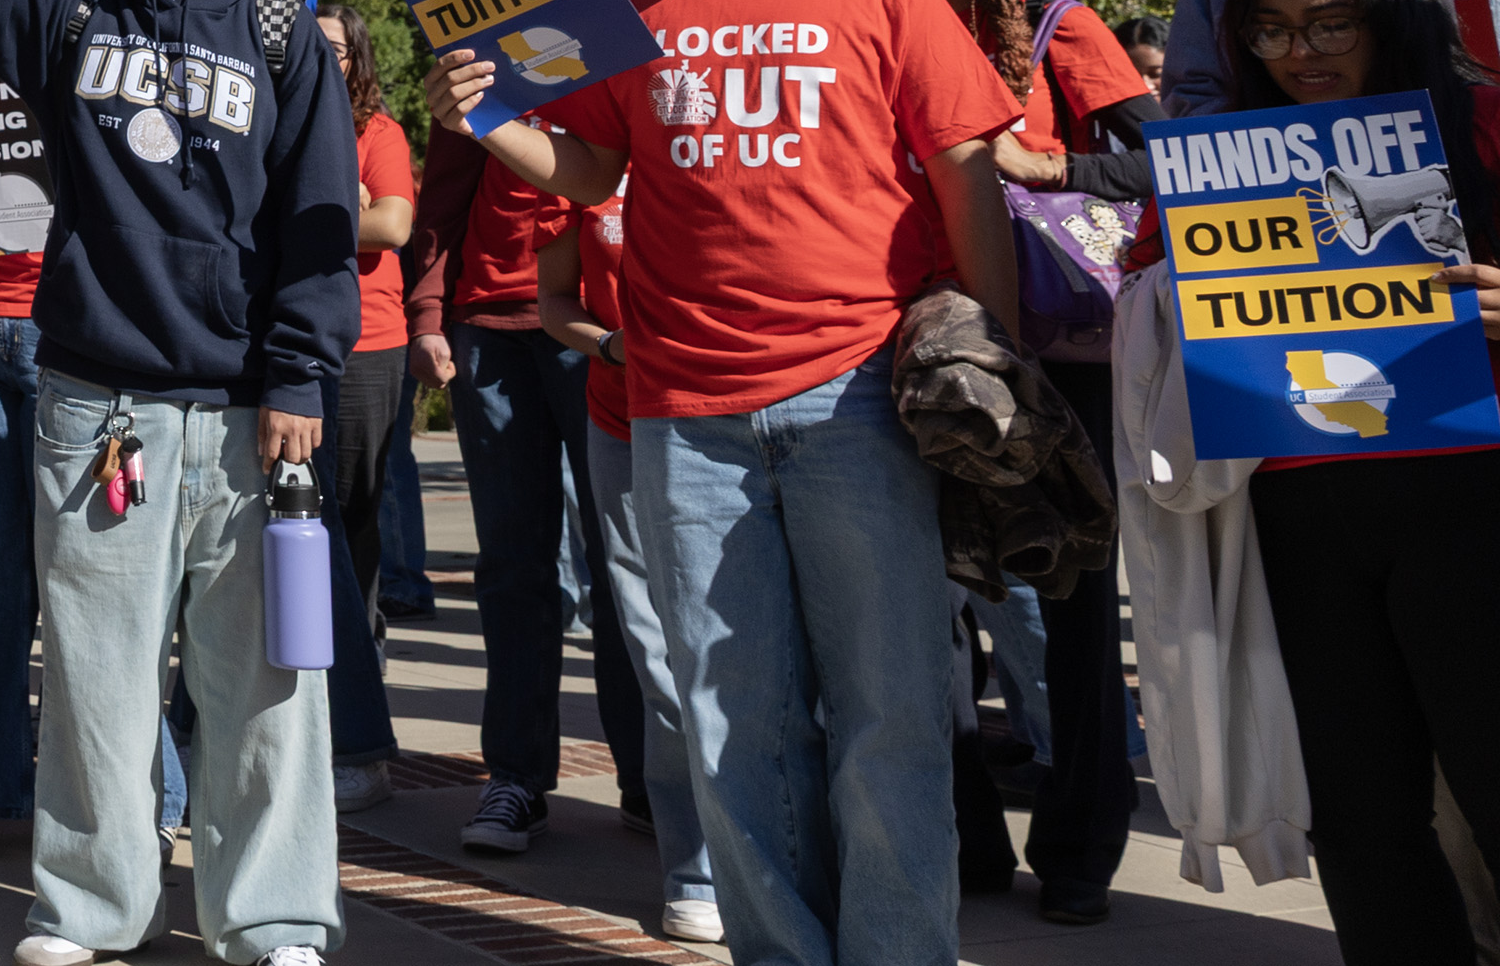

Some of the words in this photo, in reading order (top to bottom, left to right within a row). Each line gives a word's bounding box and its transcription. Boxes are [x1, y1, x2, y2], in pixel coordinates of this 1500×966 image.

[136, 35, 147, 46] OF
[189, 44, 216, 63] SANTA
[217, 54, 255, 78] BARBARA
[655, 22, 829, 57] LOCKED
[74, 46, 256, 133] UCSB
[725, 65, 836, 128] UT
[98, 114, 122, 129] EST
[658, 104, 693, 114] STUDENT
[189, 136, 221, 152] 1944
[670, 134, 724, 168] OF
[738, 133, 801, 167] UC
[1148, 122, 1324, 195] HANDS
[1331, 110, 1427, 176] OFF
[1184, 215, 1304, 256] OUR
[1196, 279, 1435, 328] TUITION
[1290, 392, 1304, 402] UC
[1308, 391, 1342, 401] Student
[1343, 387, 1392, 399] Association
